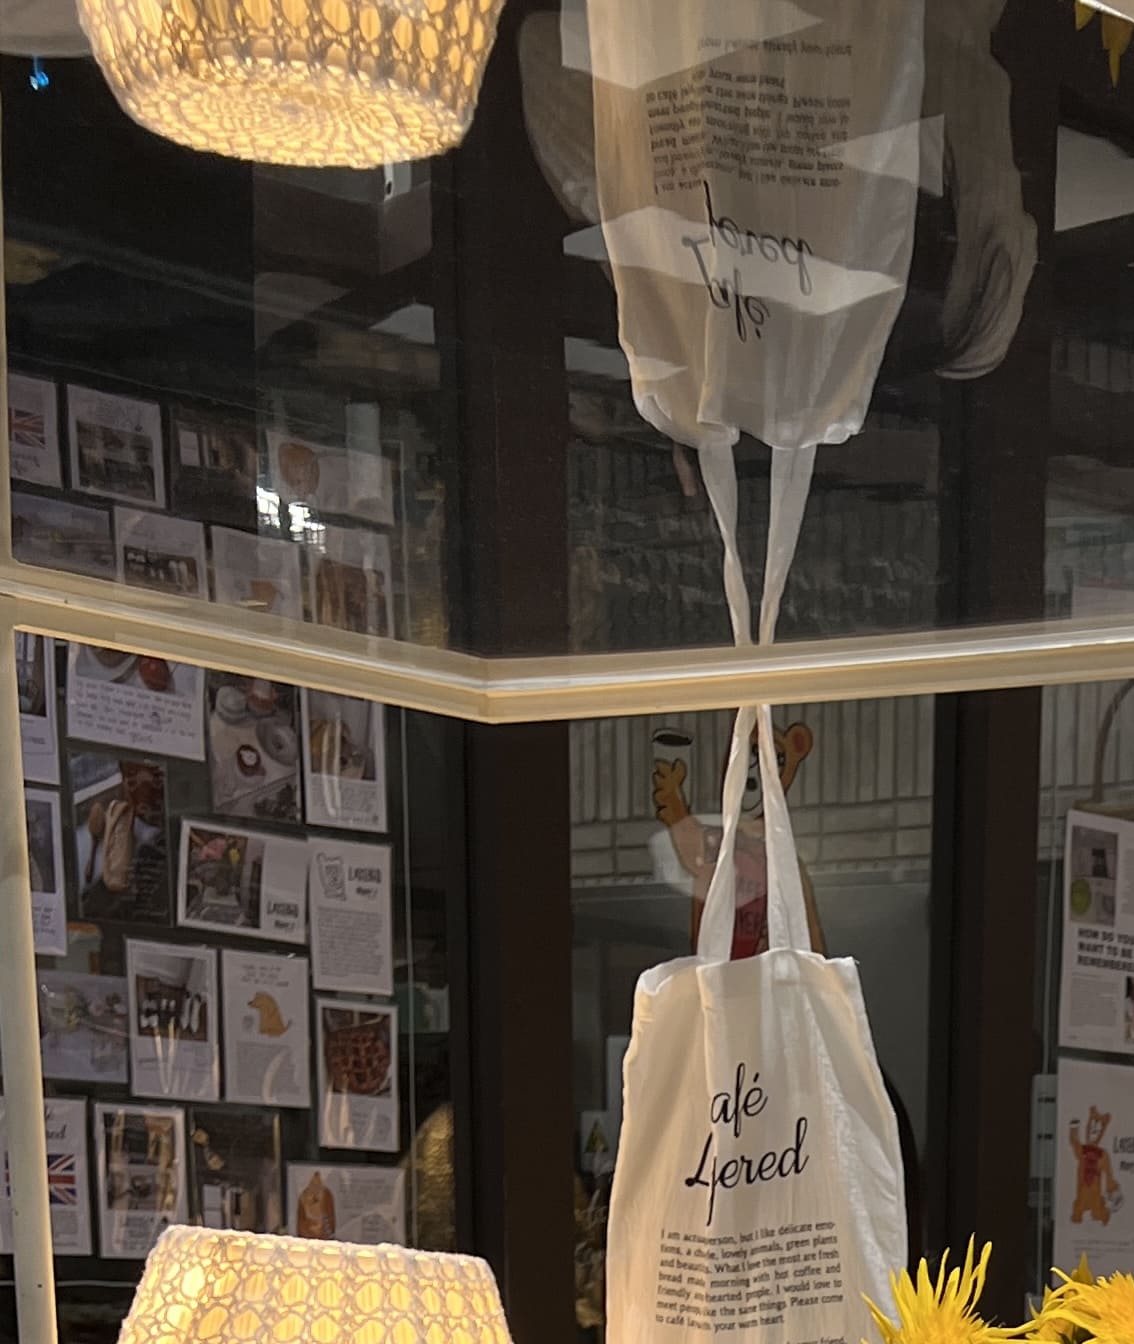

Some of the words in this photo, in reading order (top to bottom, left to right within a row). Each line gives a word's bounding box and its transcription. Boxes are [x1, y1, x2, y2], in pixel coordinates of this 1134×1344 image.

[1078, 928, 1098, 939] HOW
[1078, 941, 1104, 954] WANT
[1106, 945, 1118, 956] TO
[1121, 948, 1132, 958] BE
[787, 1239, 810, 1251] green
[826, 1263, 841, 1273] and
